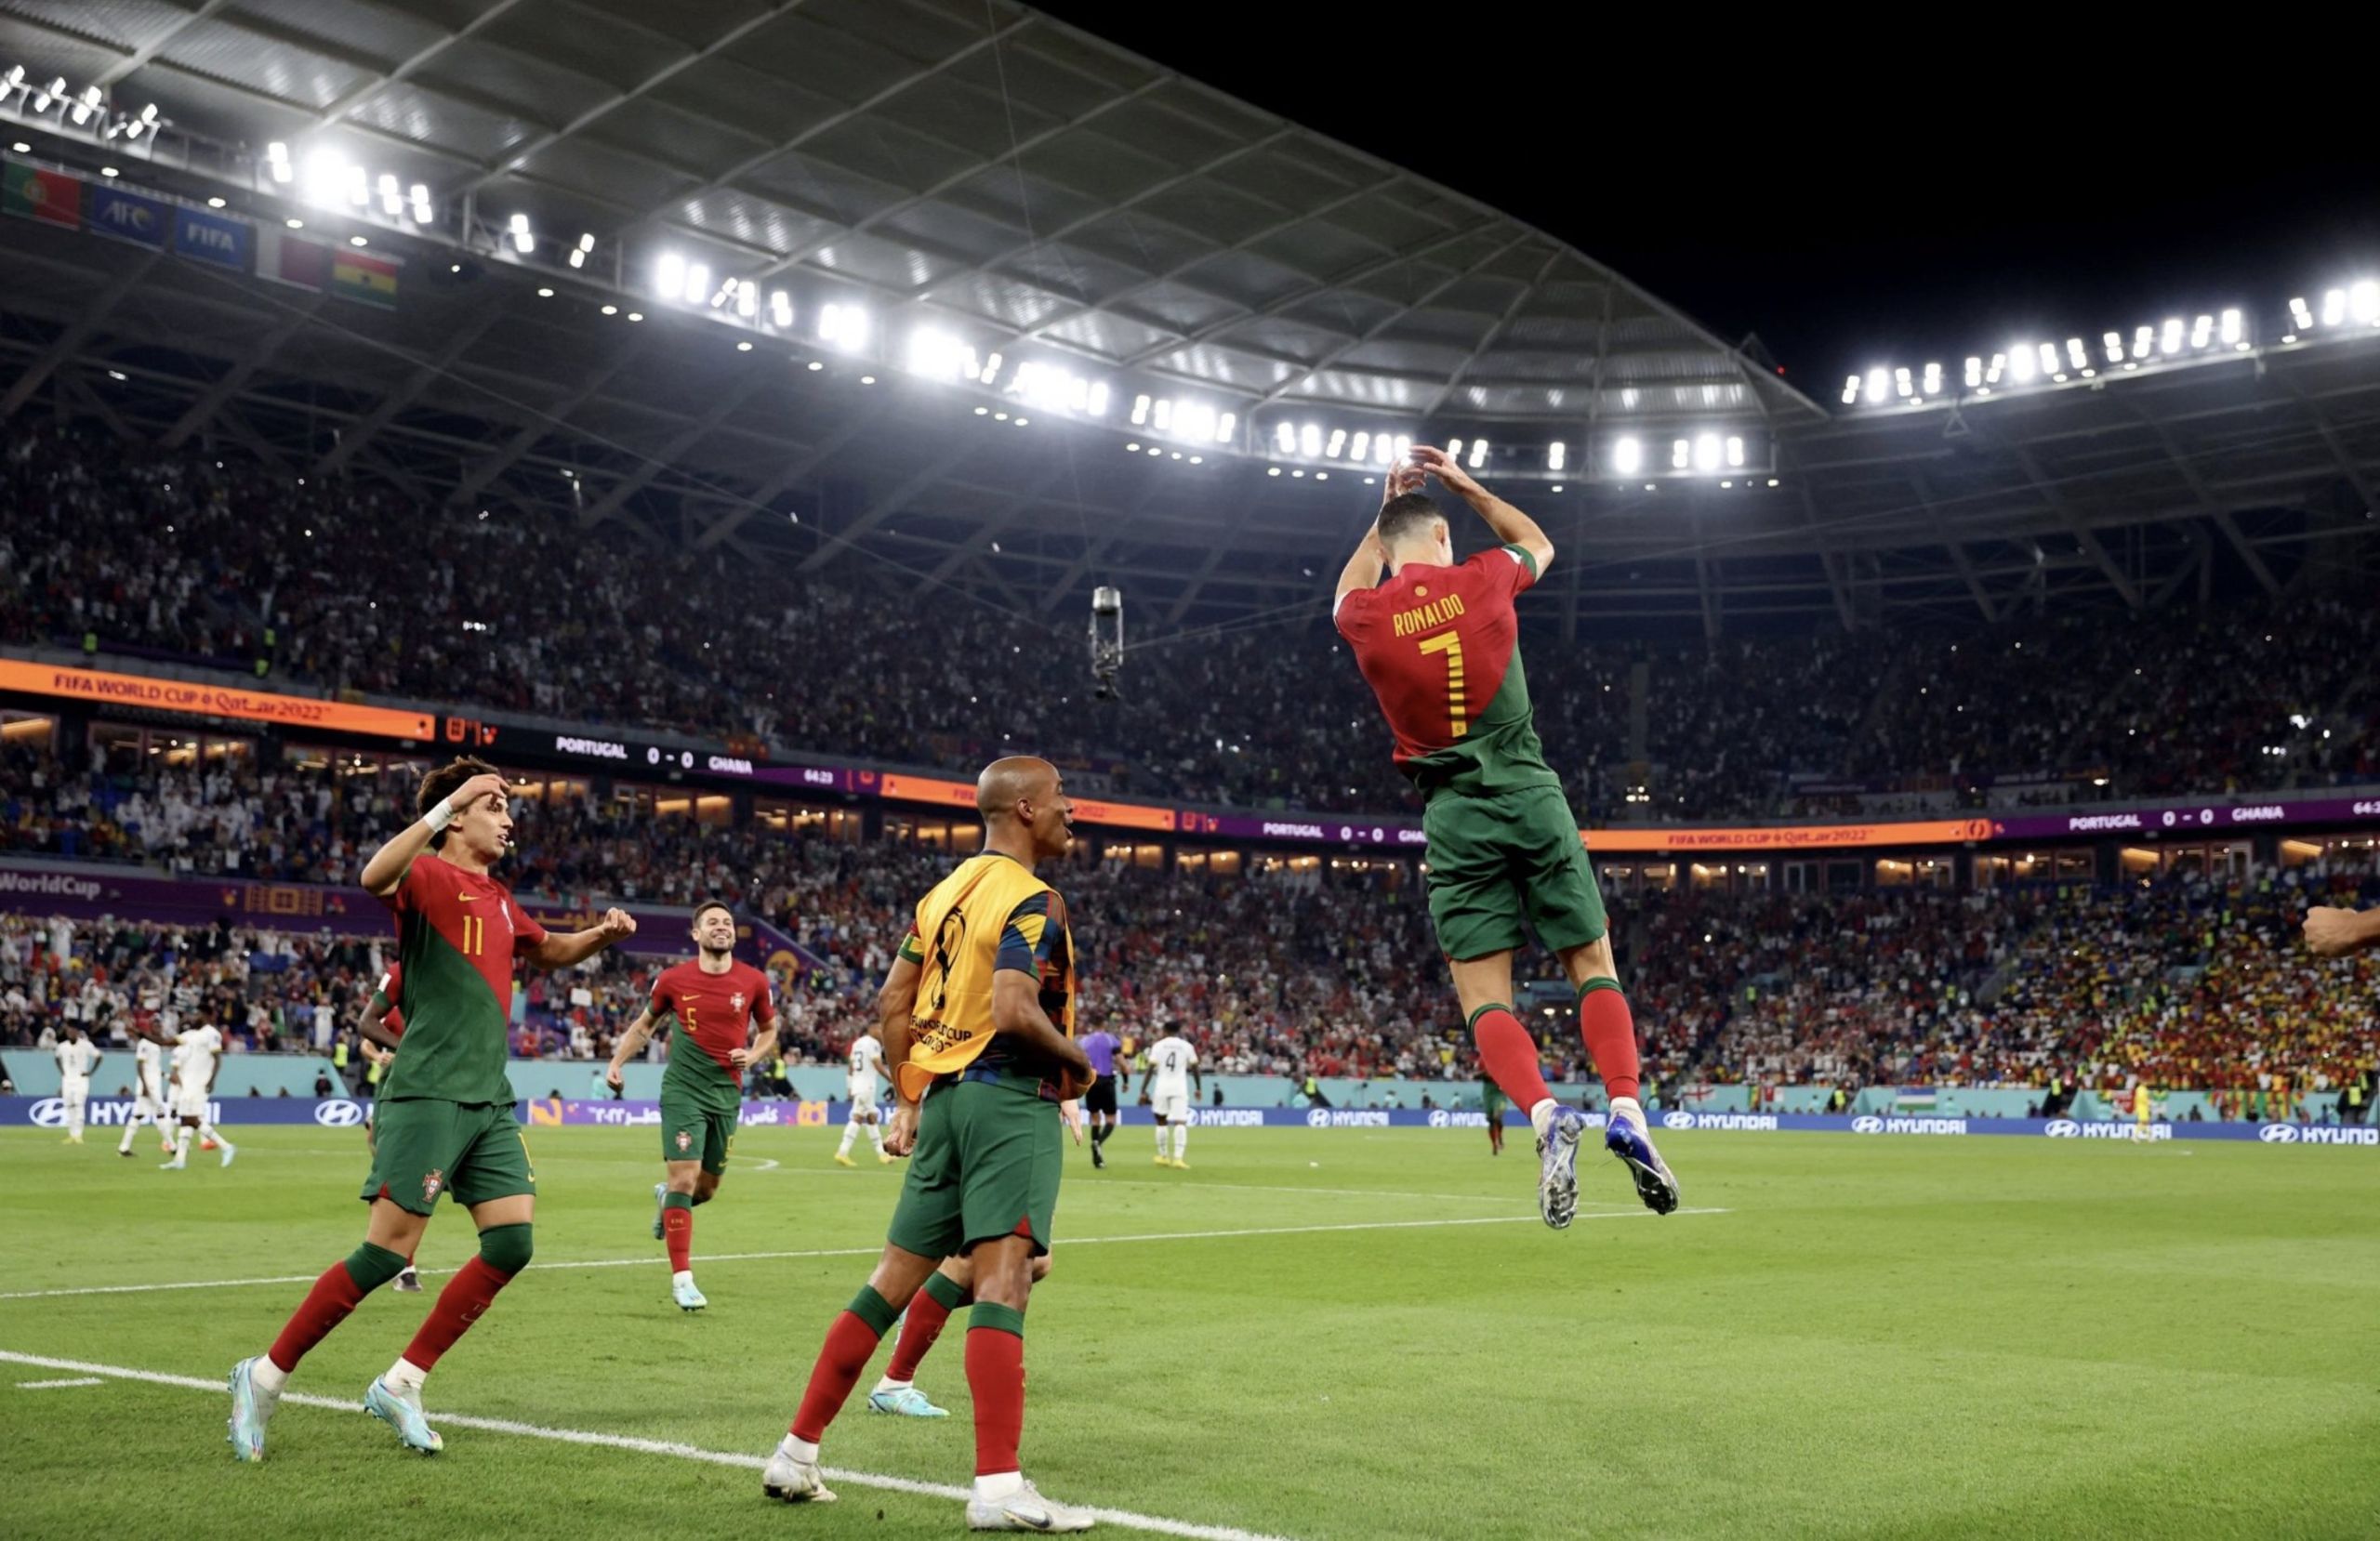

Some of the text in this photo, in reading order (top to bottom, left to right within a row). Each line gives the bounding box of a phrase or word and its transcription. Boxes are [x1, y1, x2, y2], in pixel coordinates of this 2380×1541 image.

[188, 222, 234, 253] FIFA
[1393, 593, 1465, 638] RONALDO
[54, 674, 92, 692] FIFA
[97, 679, 160, 700] WORLD
[165, 687, 198, 705] CUP
[1419, 630, 1467, 737] 7
[556, 736, 628, 758] PORTUGAL
[647, 746, 659, 764] 0
[681, 751, 694, 769] 0
[708, 756, 753, 774] GHANA
[2069, 814, 2141, 831] PORTUGAL
[2162, 810, 2175, 826] 0
[2200, 809, 2214, 824] 0
[2231, 805, 2284, 822] GHANA
[1263, 823, 1324, 838] PORTUGAL
[1341, 826, 1353, 841] 0
[1372, 828, 1384, 842] 0
[1398, 829, 1428, 843] GHA
[1668, 835, 1696, 846] FIFA
[1698, 834, 1743, 845] WORLD
[1746, 833, 1770, 844] CUP
[462, 915, 483, 955] 11
[686, 1007, 696, 1032] 5
[946, 1027, 972, 1041] CUP
[854, 1050, 864, 1072] 3
[1166, 1051, 1176, 1072] 4
[1200, 1110, 1263, 1126] HYUNDAI
[1451, 1112, 1490, 1127] HYUN
[1699, 1113, 1778, 1130] HYUNDAI
[1886, 1118, 1966, 1135] HYUNDAI
[2301, 1122, 2380, 1145] HYUND
